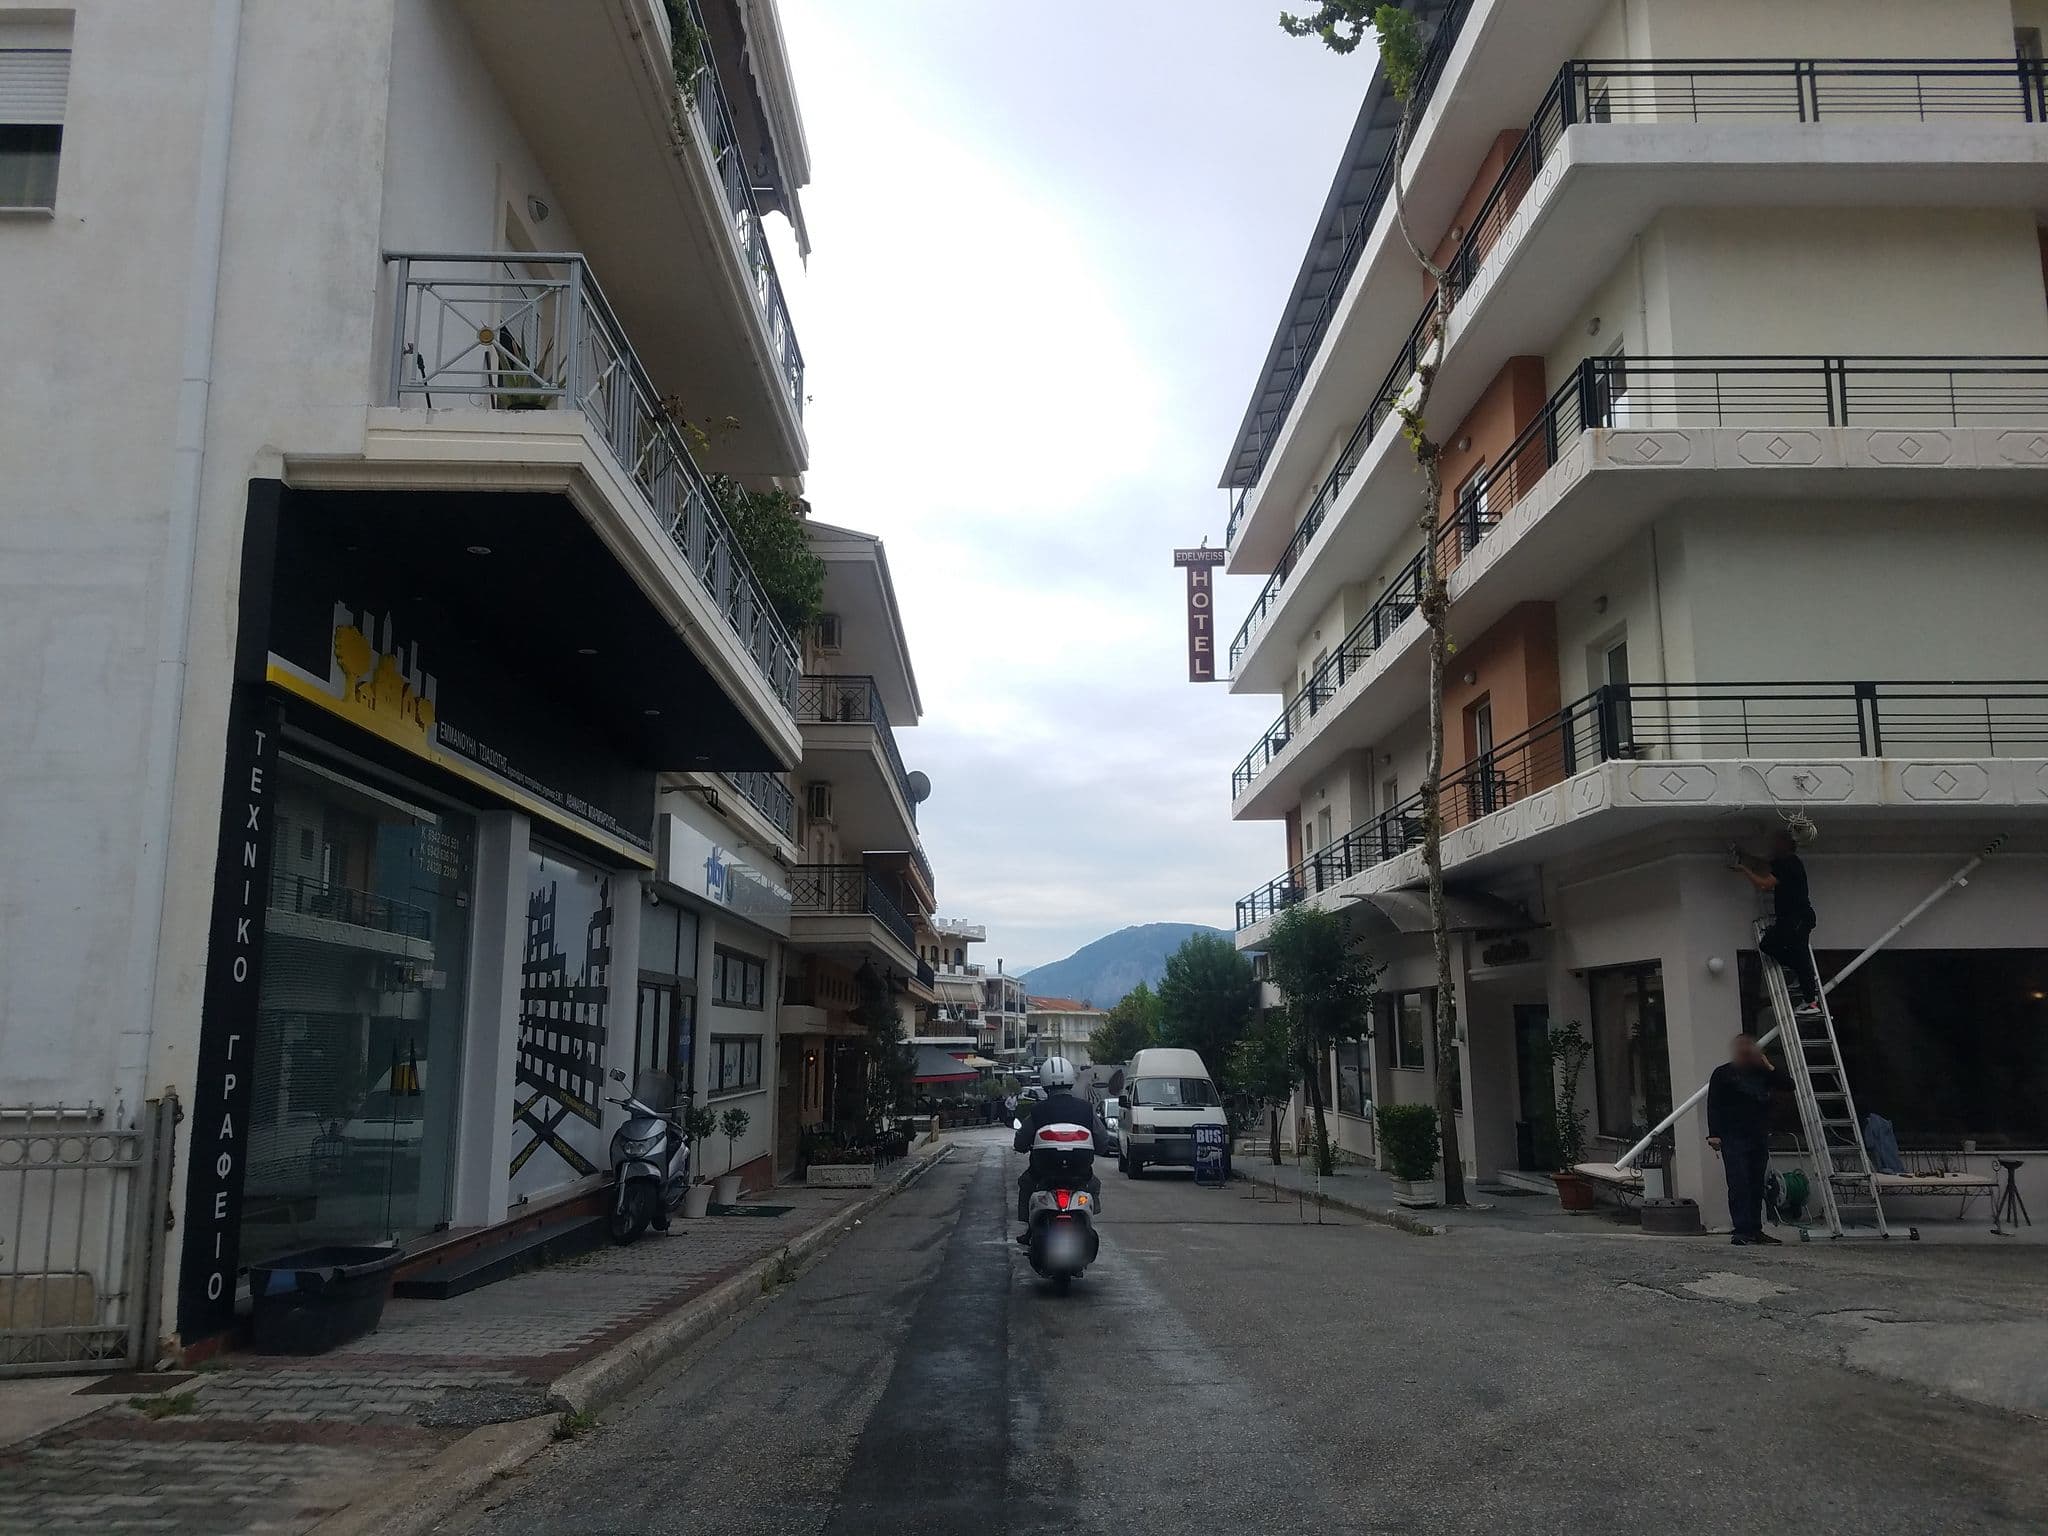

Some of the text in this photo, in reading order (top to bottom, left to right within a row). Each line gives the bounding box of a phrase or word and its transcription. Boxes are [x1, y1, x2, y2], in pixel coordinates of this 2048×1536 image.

[1176, 551, 1223, 561] EDELWEISS
[1192, 571, 1209, 674] HOTEL
[206, 729, 266, 1301] ΤΕΧΝΙΚΟ ΓΡΑΦΕΙΟ
[1196, 1129, 1222, 1143] BUS
